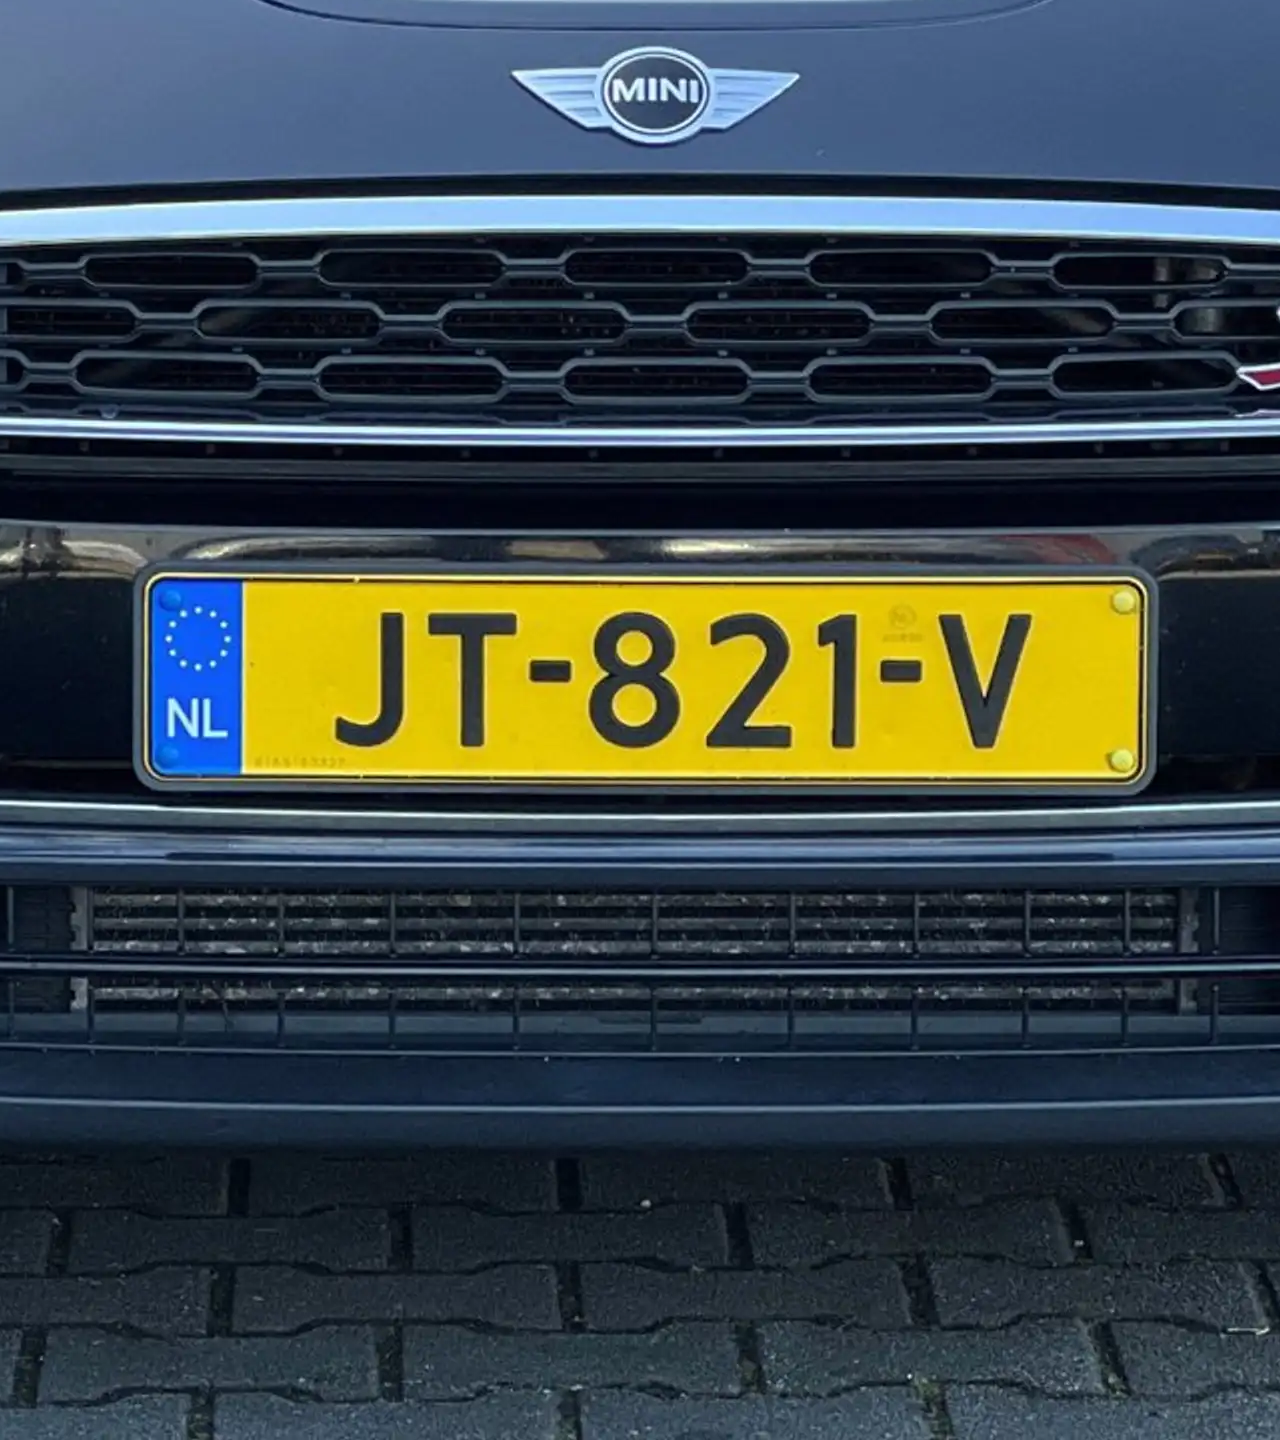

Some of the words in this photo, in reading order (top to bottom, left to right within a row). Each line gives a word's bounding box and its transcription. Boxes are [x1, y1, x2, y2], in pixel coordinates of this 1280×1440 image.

[612, 77, 700, 104] MINI
[334, 611, 1033, 749] JT-821-V
[167, 697, 229, 739] NL
